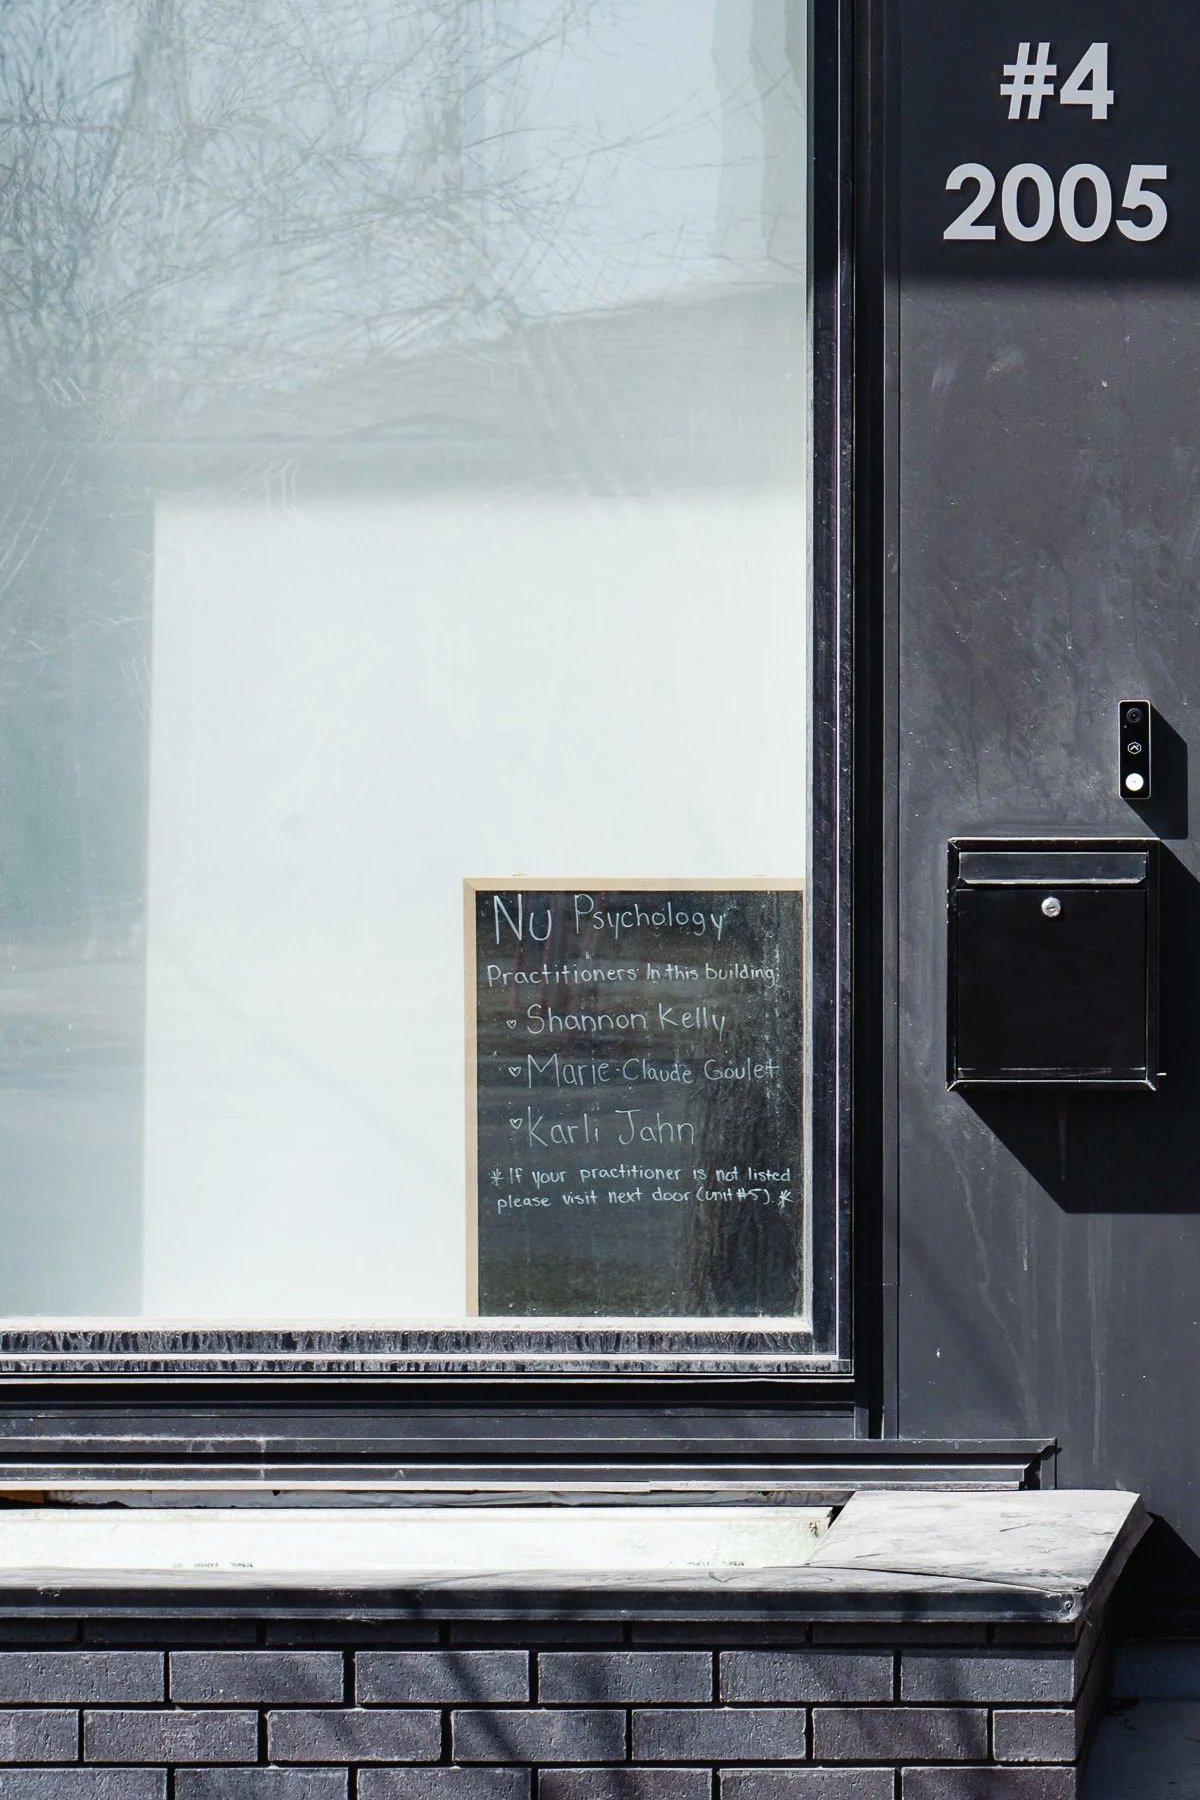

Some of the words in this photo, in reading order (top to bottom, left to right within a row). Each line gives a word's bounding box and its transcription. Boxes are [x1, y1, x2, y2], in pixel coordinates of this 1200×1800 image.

[1000, 42, 1114, 120] #4
[943, 162, 1168, 242] 2005
[574, 893, 727, 941] Psychology
[664, 965, 699, 981] this
[526, 1003, 647, 1035] Shannon
[659, 1002, 726, 1042] Kelly
[527, 1053, 693, 1088] Marie-Claude
[704, 1057, 780, 1082] Goulet
[527, 1106, 599, 1148] Karli
[615, 1108, 695, 1145] Jahn
[532, 1170, 567, 1189] your
[580, 1164, 683, 1182] practitioner
[693, 1167, 707, 1180] is
[716, 1166, 738, 1181] not
[748, 1167, 791, 1181] listed
[497, 1194, 551, 1214] please
[562, 1190, 597, 1206] visit
[608, 1188, 642, 1203] next
[652, 1188, 690, 1202] door
[696, 1188, 733, 1204] (unit
